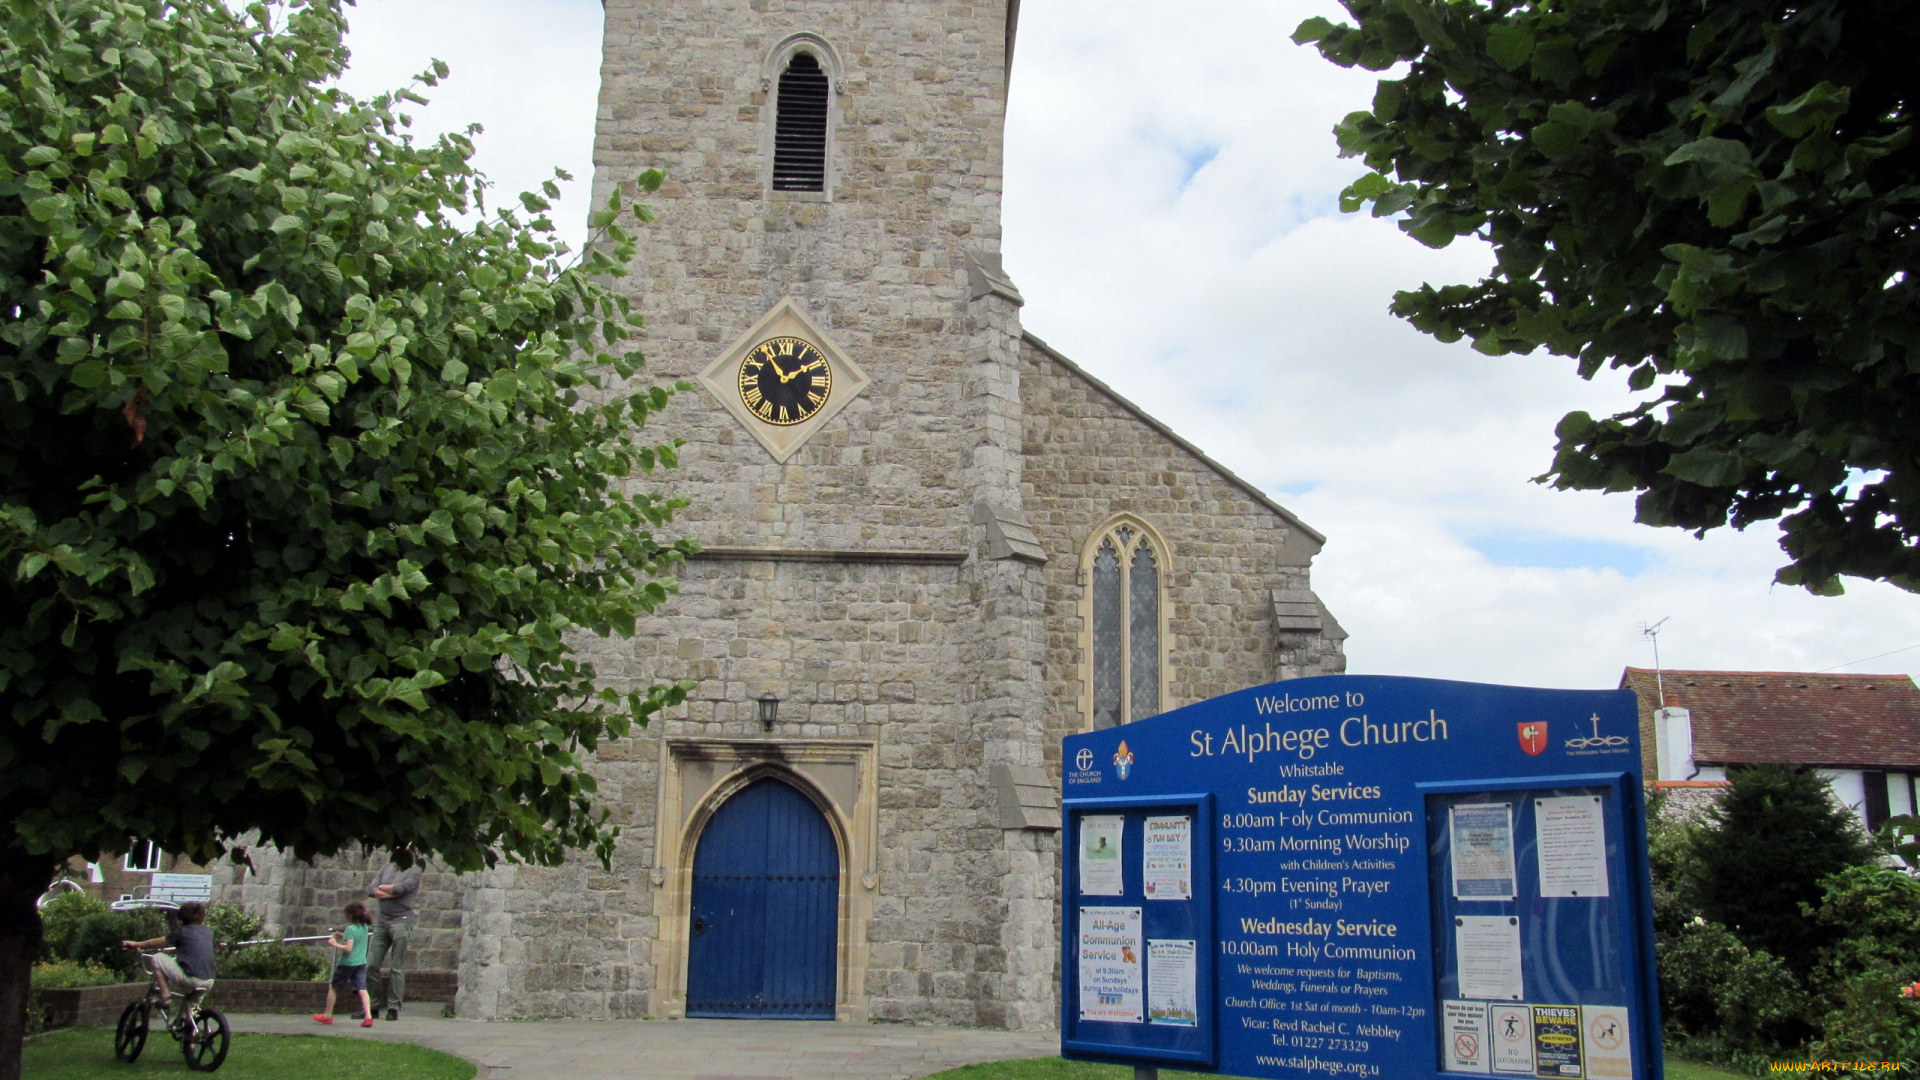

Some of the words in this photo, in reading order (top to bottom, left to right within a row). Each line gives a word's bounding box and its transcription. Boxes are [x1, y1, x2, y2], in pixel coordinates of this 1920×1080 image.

[1255, 693, 1340, 715] Welcome
[1345, 691, 1364, 708] to
[1190, 729, 1214, 757] St
[1221, 722, 1330, 763] Alphege
[1340, 709, 1448, 747] Church
[1079, 770, 1102, 778] CHURCH
[1279, 761, 1344, 778] Whitstable
[1247, 784, 1306, 807] Sunday
[1311, 782, 1381, 801] Services
[1149, 821, 1187, 830] COMMUNITY
[1222, 813, 1275, 829] 8.00am
[1318, 807, 1413, 826] Communion
[1153, 834, 1165, 843] FUN
[1166, 833, 1181, 842] DAY
[1223, 837, 1275, 852] 9.30am
[1279, 835, 1342, 855] Morning
[1345, 832, 1410, 854] Worship
[1279, 861, 1300, 871] with
[1302, 859, 1350, 870] Children's
[1352, 860, 1396, 870] Activities
[1222, 878, 1276, 897] 4.30pm
[1281, 877, 1338, 898] Evening
[1342, 877, 1390, 898] Prayer
[1305, 899, 1343, 912] Sunday)
[1093, 920, 1126, 932] All-Age
[1240, 917, 1332, 941] Wednesday
[1336, 918, 1397, 937] Service
[1082, 934, 1136, 946] Communion
[1082, 949, 1117, 960] Service
[1220, 940, 1278, 956] 10.00am
[1287, 941, 1320, 962] Holy
[1324, 942, 1416, 961] Communion
[1102, 977, 1127, 985] Sundays
[1237, 964, 1252, 974] We
[1254, 965, 1295, 976] welcome
[1296, 967, 1335, 982] requests
[1336, 966, 1351, 978] for
[1356, 968, 1403, 982] Baptisms,
[1083, 985, 1102, 993] during
[1113, 986, 1138, 994] holidays
[1251, 979, 1297, 994] Weddings,
[1300, 981, 1338, 994] Funerals
[1340, 985, 1352, 994] or
[1353, 985, 1388, 998] Prayers
[1225, 996, 1257, 1009] Church
[1259, 998, 1287, 1010] Office
[1290, 1000, 1303, 1011] 1st
[1304, 1001, 1318, 1012] Sat
[1320, 1001, 1330, 1013] of
[1331, 1002, 1361, 1014] month
[1535, 1008, 1577, 1017] THIEVES
[1241, 1016, 1270, 1030] Vicar:
[1273, 1018, 1298, 1032] Revd
[1301, 1020, 1335, 1034] Rachel
[1338, 1024, 1350, 1035] C.
[1535, 1016, 1578, 1025] BEWARE
[1271, 1034, 1288, 1046] Tel.
[1291, 1035, 1324, 1049] 01227
[1328, 1038, 1369, 1052] 273329
[1507, 1048, 1519, 1056] NO
